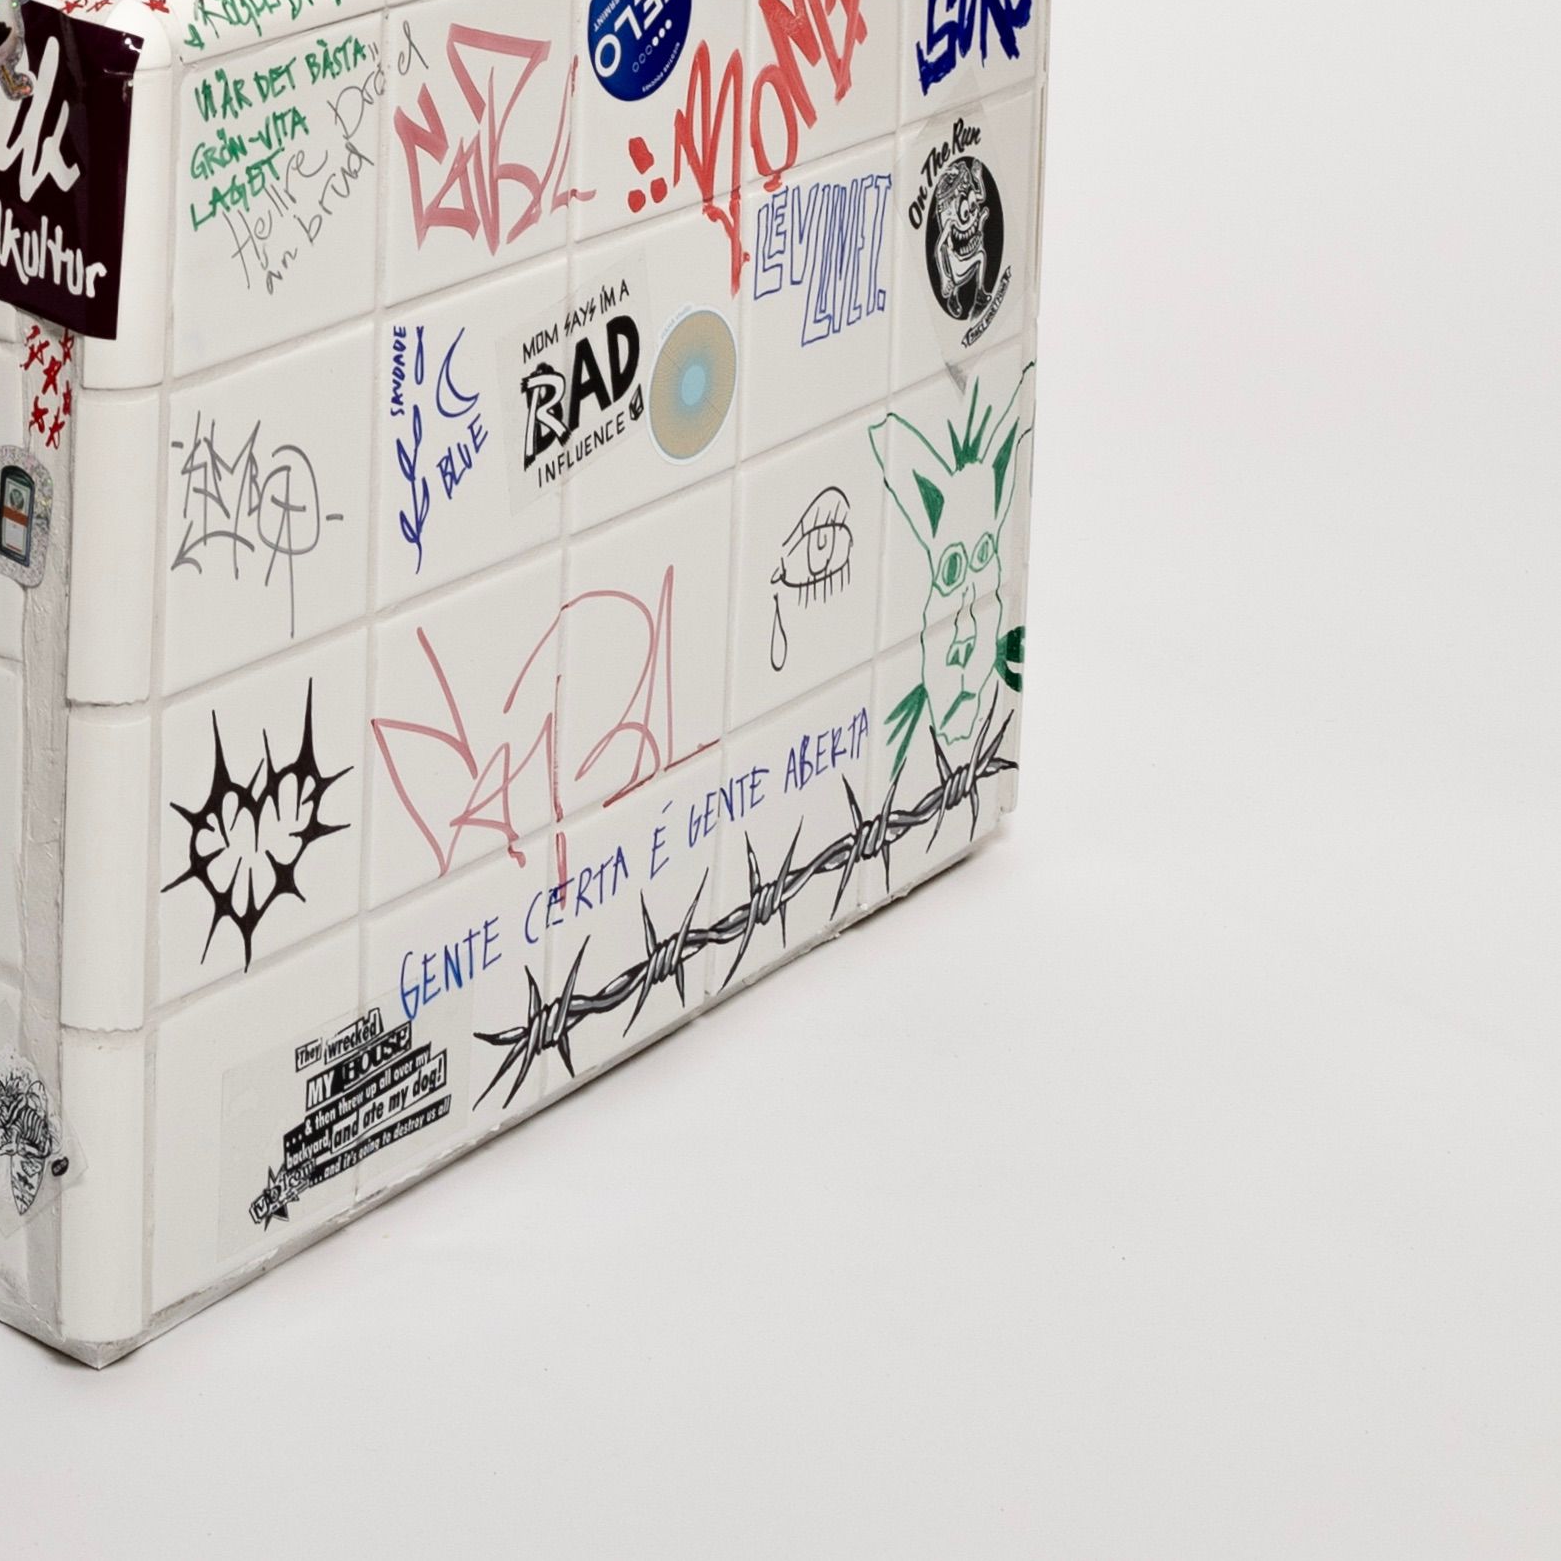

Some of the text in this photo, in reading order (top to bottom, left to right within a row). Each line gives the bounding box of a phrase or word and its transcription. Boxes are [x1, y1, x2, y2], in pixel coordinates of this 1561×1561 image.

[214, 68, 253, 120] ÄR
[253, 56, 297, 103] DET
[305, 36, 368, 85] BÄSTA
[190, 147, 285, 232] LAGET
[909, 117, 982, 230] On The Run
[522, 323, 559, 364] MOM
[564, 297, 596, 337] SAYS
[619, 279, 630, 302] A
[389, 326, 407, 417] SAUDADE
[521, 314, 641, 473] RAD
[436, 414, 489, 500] BLUE
[538, 411, 626, 488] INFLUENCE
[400, 707, 869, 1021] GENTE CERTA É GENTE ABERTA
[299, 1019, 379, 1066] They wrecked
[308, 1026, 410, 1107] MY HOUSE
[315, 1108, 336, 1129] then
[338, 1094, 365, 1115] threw
[366, 1085, 377, 1105] up
[379, 1070, 392, 1088] all
[394, 1061, 413, 1081] over
[334, 1118, 359, 1151] and
[363, 1100, 384, 1130] ate
[388, 1086, 409, 1114] my
[412, 1058, 443, 1098] dog!
[393, 1113, 425, 1141] destroy
